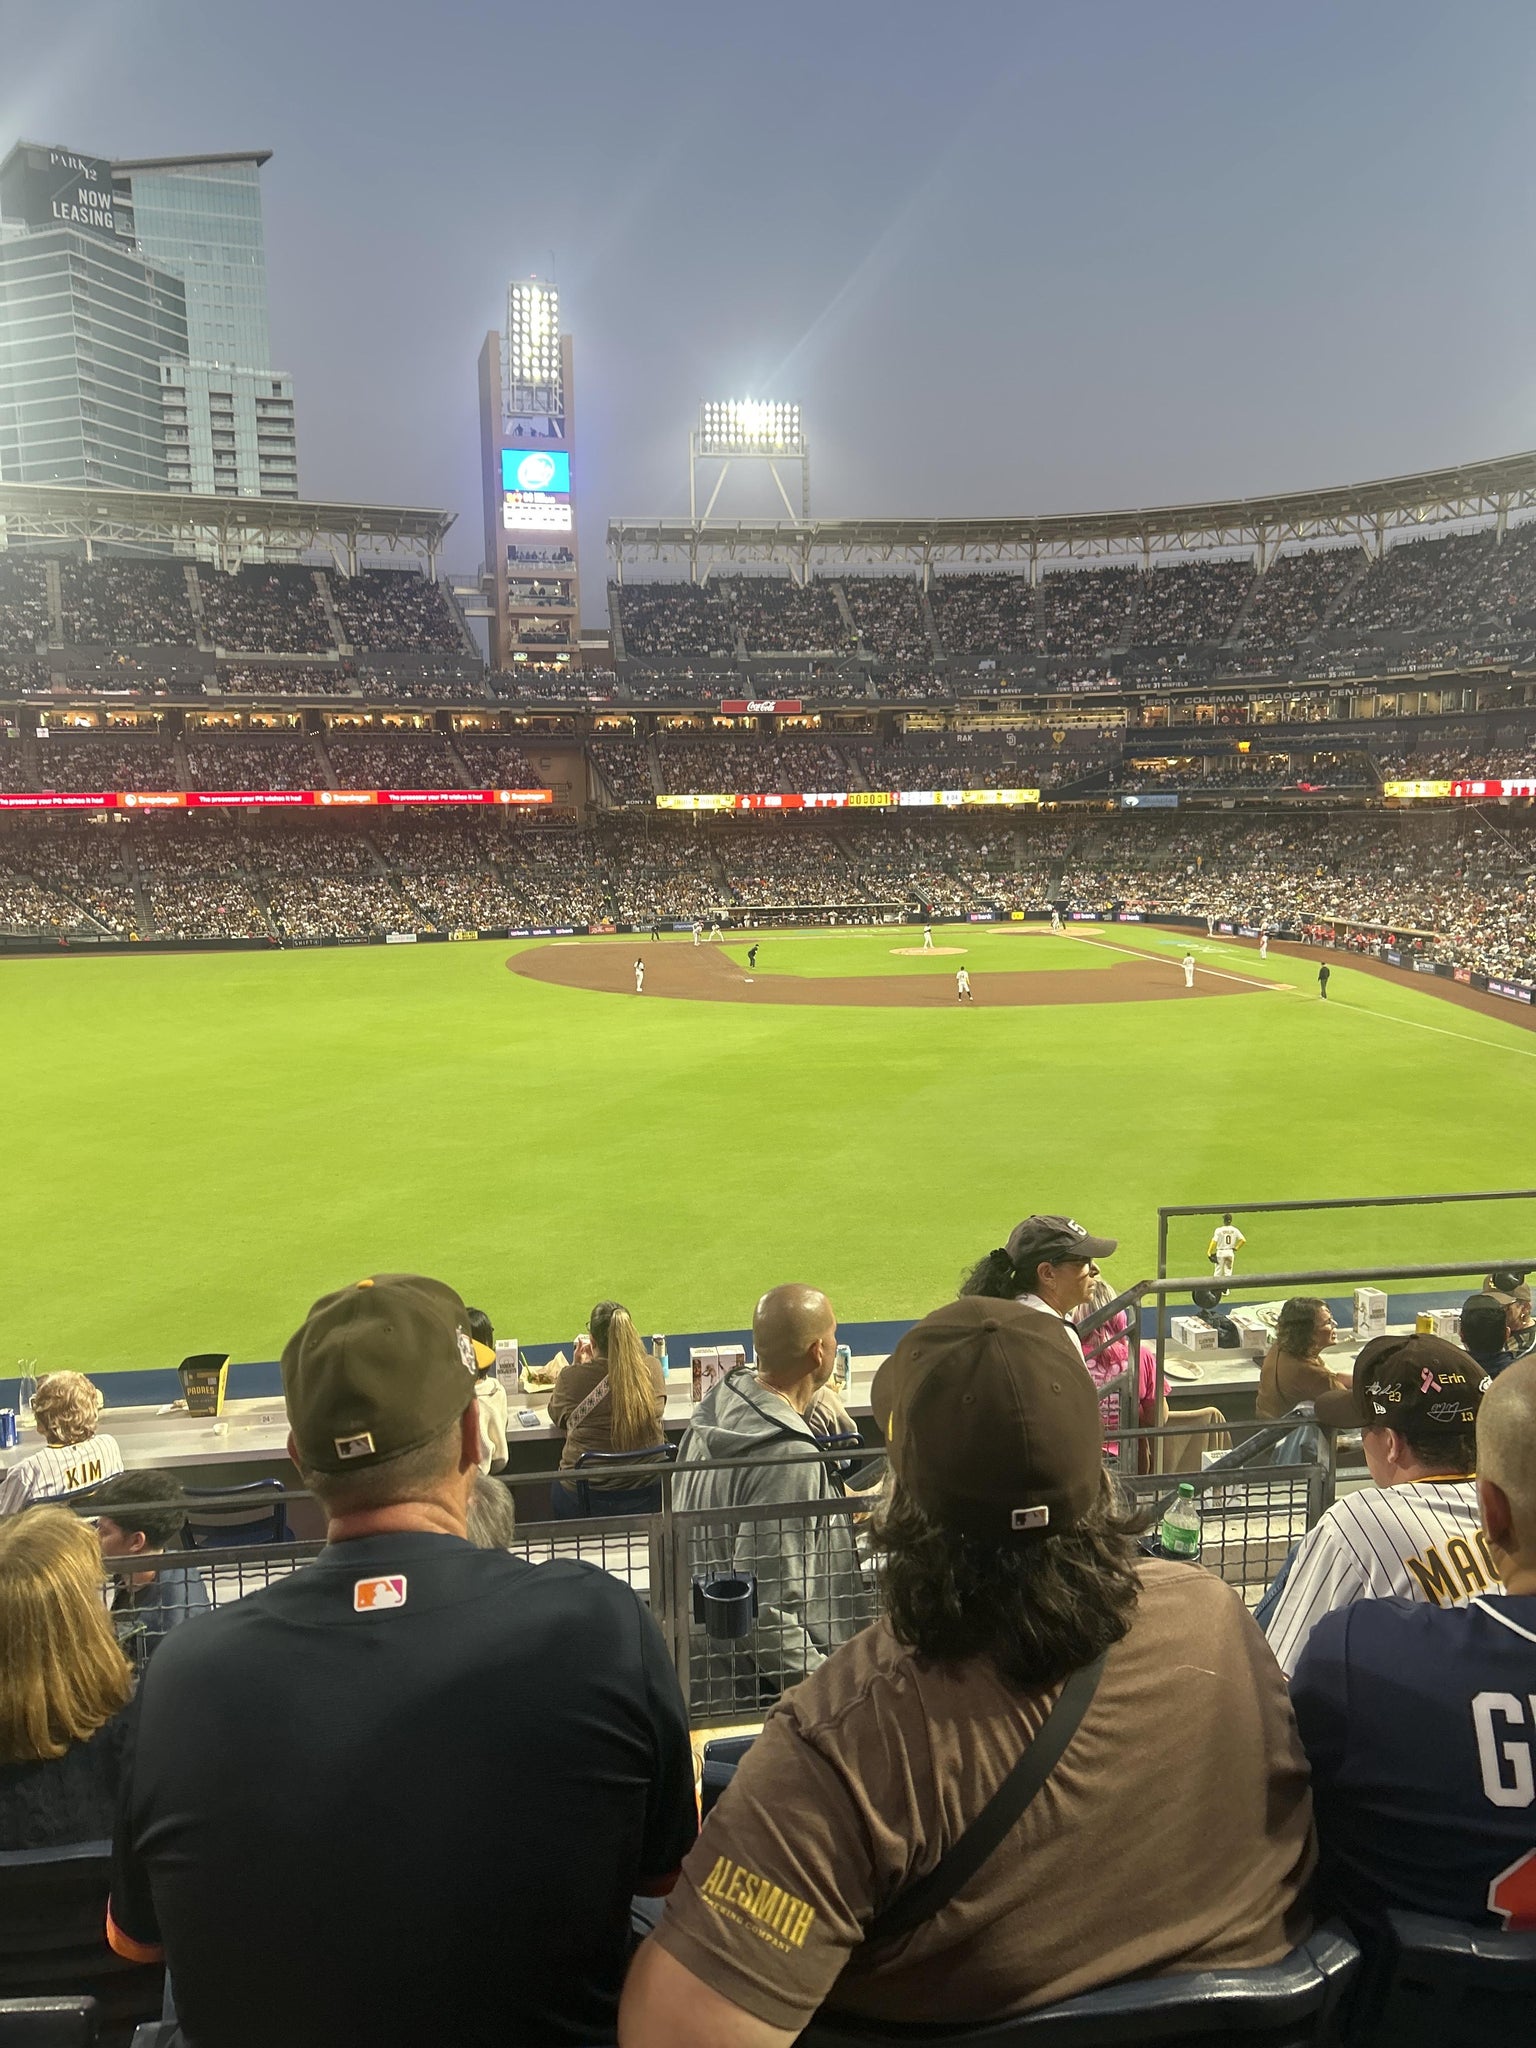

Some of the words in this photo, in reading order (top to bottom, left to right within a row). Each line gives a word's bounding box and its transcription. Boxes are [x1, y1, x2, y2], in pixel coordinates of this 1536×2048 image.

[51, 152, 86, 170] PARK
[85, 168, 97, 181] 12
[78, 188, 111, 210] NOW
[52, 200, 113, 229] LEASING
[1140, 697, 1179, 707] JERRY
[1184, 694, 1244, 705] COLEMAN
[1249, 690, 1324, 701] BROADCAST
[1329, 687, 1378, 697] CENTER
[747, 701, 776, 712] Coca-Cola
[957, 734, 973, 742] RAK
[138, 796, 179, 804] Snapdragon
[333, 794, 371, 803] Snapdragon
[1225, 1235, 1231, 1244] 0
[1438, 1373, 1466, 1384] Erin
[187, 1386, 215, 1396] PADRES
[1388, 1390, 1401, 1402] 23
[1461, 1412, 1474, 1422] 13
[66, 1460, 101, 1489] KIM
[1472, 1691, 1536, 1808] G
[701, 1855, 816, 1950] ALESMITH
[702, 1894, 744, 1925] BREWING
[744, 1922, 792, 1953] COMPANY
